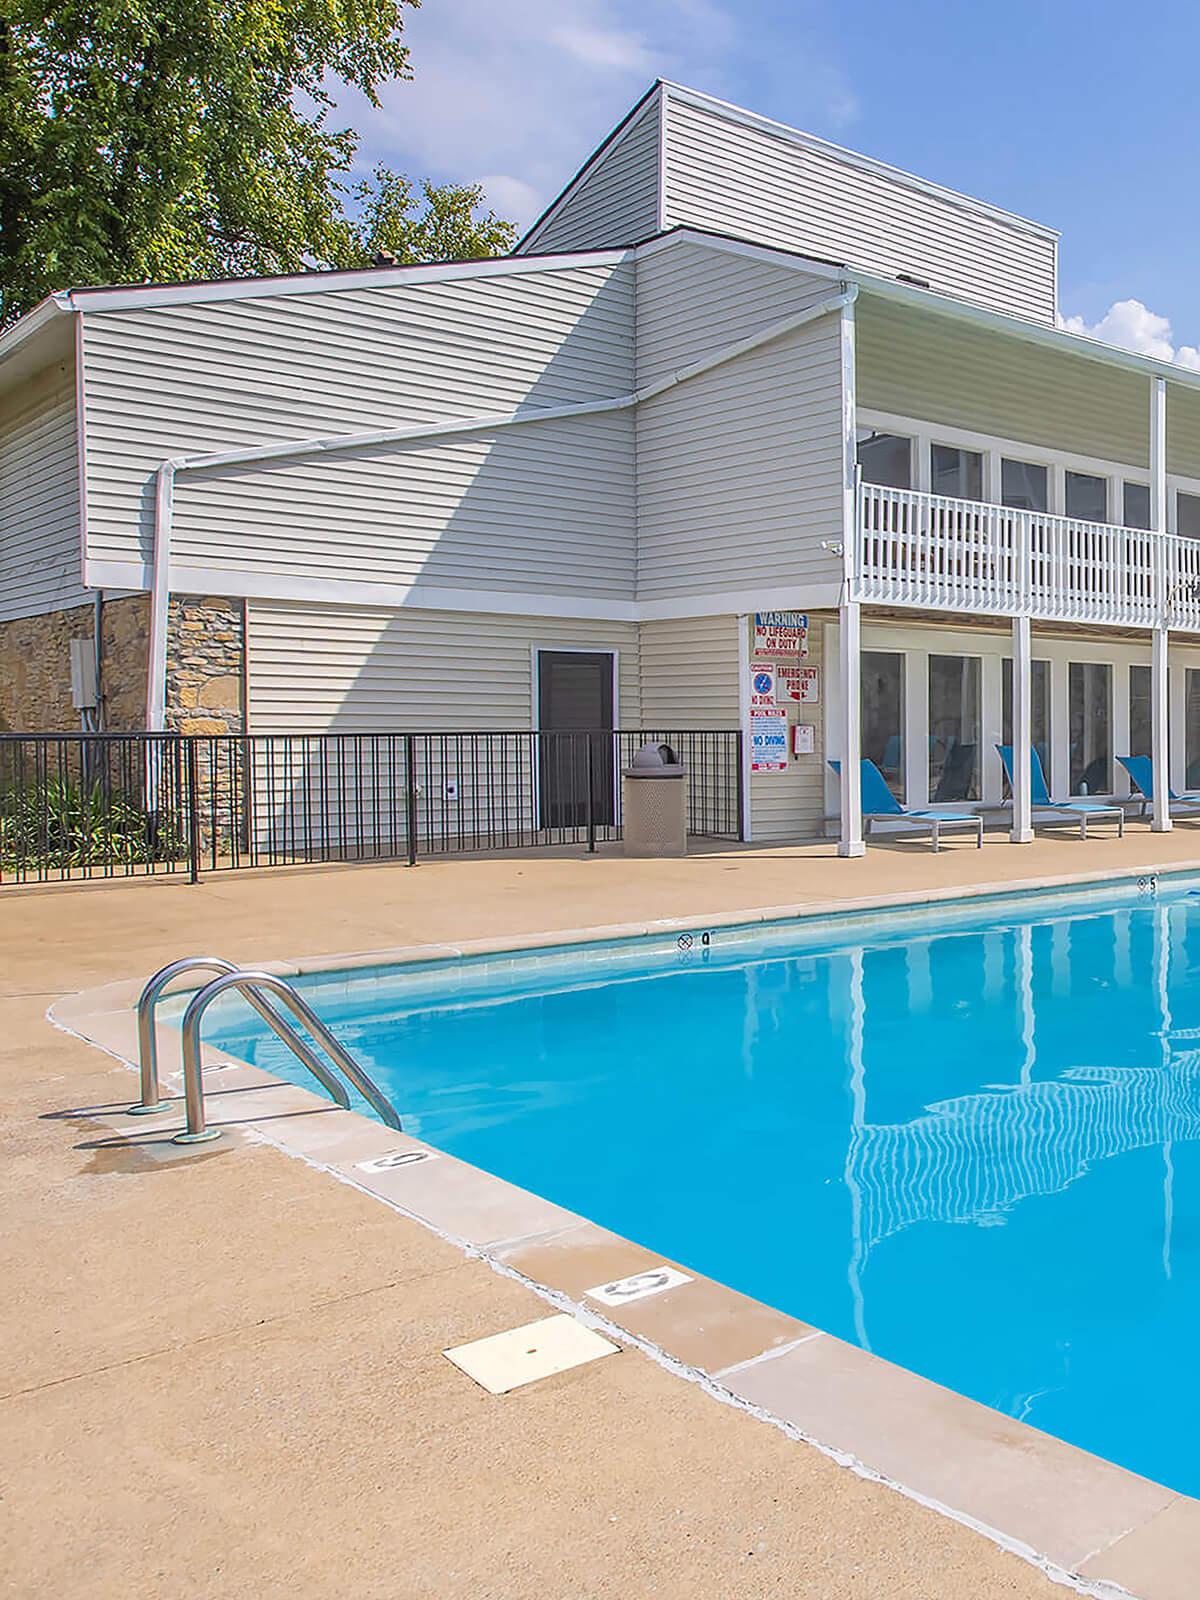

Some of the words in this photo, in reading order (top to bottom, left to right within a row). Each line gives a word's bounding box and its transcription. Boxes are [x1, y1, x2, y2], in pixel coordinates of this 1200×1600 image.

[760, 611, 805, 627] WARNING
[755, 626, 767, 636] NO
[769, 627, 806, 638] LIFEGUARD
[766, 637, 776, 648] ON
[779, 638, 797, 649] DUTY
[777, 667, 817, 680] EMERGNCY
[753, 735, 763, 746] NO
[764, 735, 785, 746] DIVING
